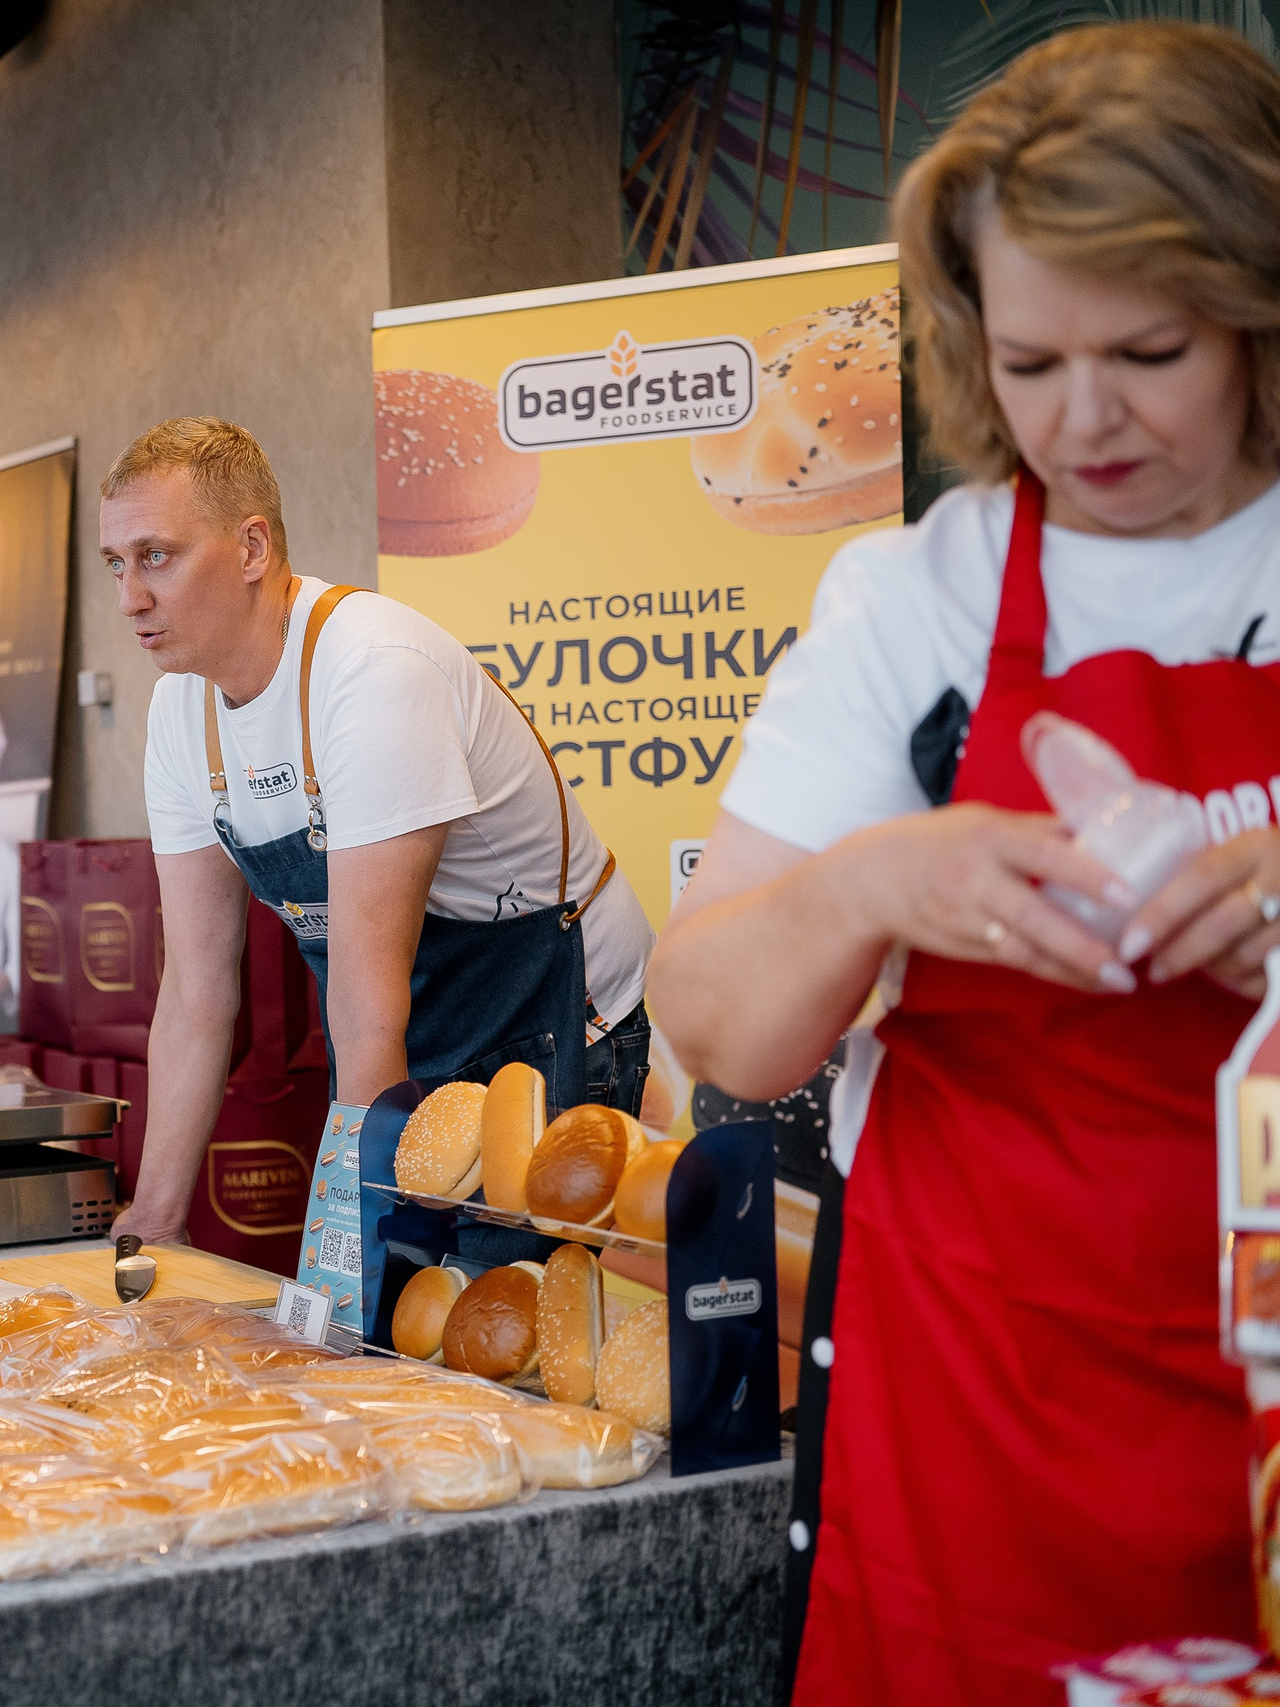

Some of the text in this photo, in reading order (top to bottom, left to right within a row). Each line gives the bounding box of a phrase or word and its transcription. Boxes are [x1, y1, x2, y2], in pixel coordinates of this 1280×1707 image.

[517, 363, 737, 422] bagerstat
[600, 403, 738, 429] FOODSERVICE
[509, 586, 746, 625] НАСТОЯЩИЕ
[551, 694, 762, 725] НАСТОЯЩЕ
[553, 736, 735, 788] СТФУ
[248, 770, 291, 790] erstat
[330, 1187, 360, 1203] ПОДАР
[336, 1205, 360, 1217] подпис
[693, 1290, 753, 1309] bagerstat
